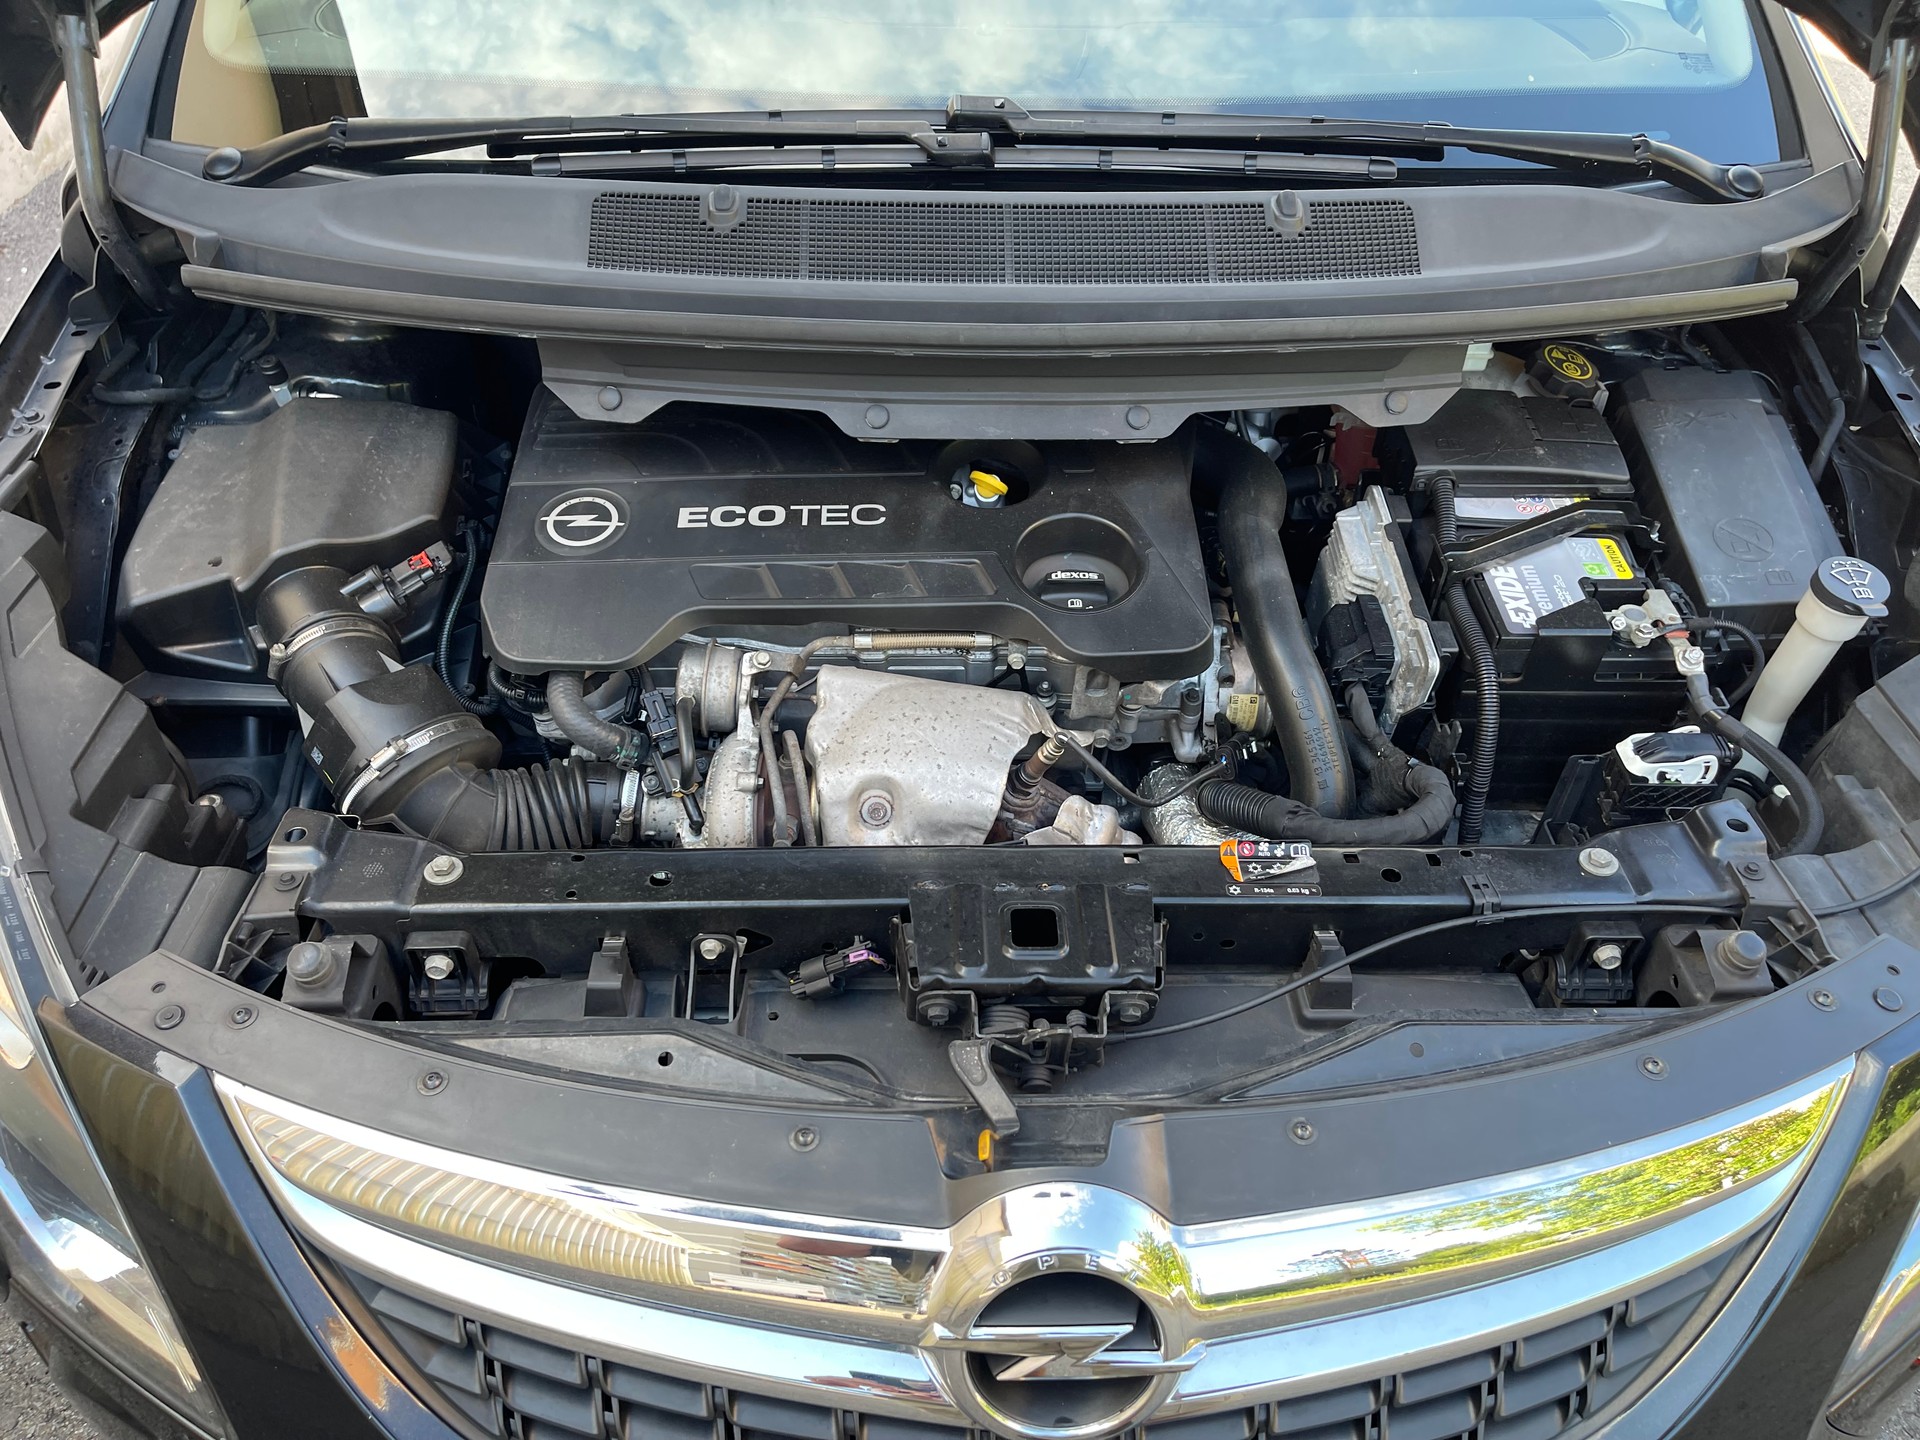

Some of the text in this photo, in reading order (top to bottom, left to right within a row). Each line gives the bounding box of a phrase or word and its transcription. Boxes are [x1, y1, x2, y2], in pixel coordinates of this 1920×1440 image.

[1051, 570, 1099, 580] dexos
[1603, 544, 1626, 573] CAUTION
[1489, 564, 1538, 629] EXIDE
[1520, 564, 1554, 616] remium
